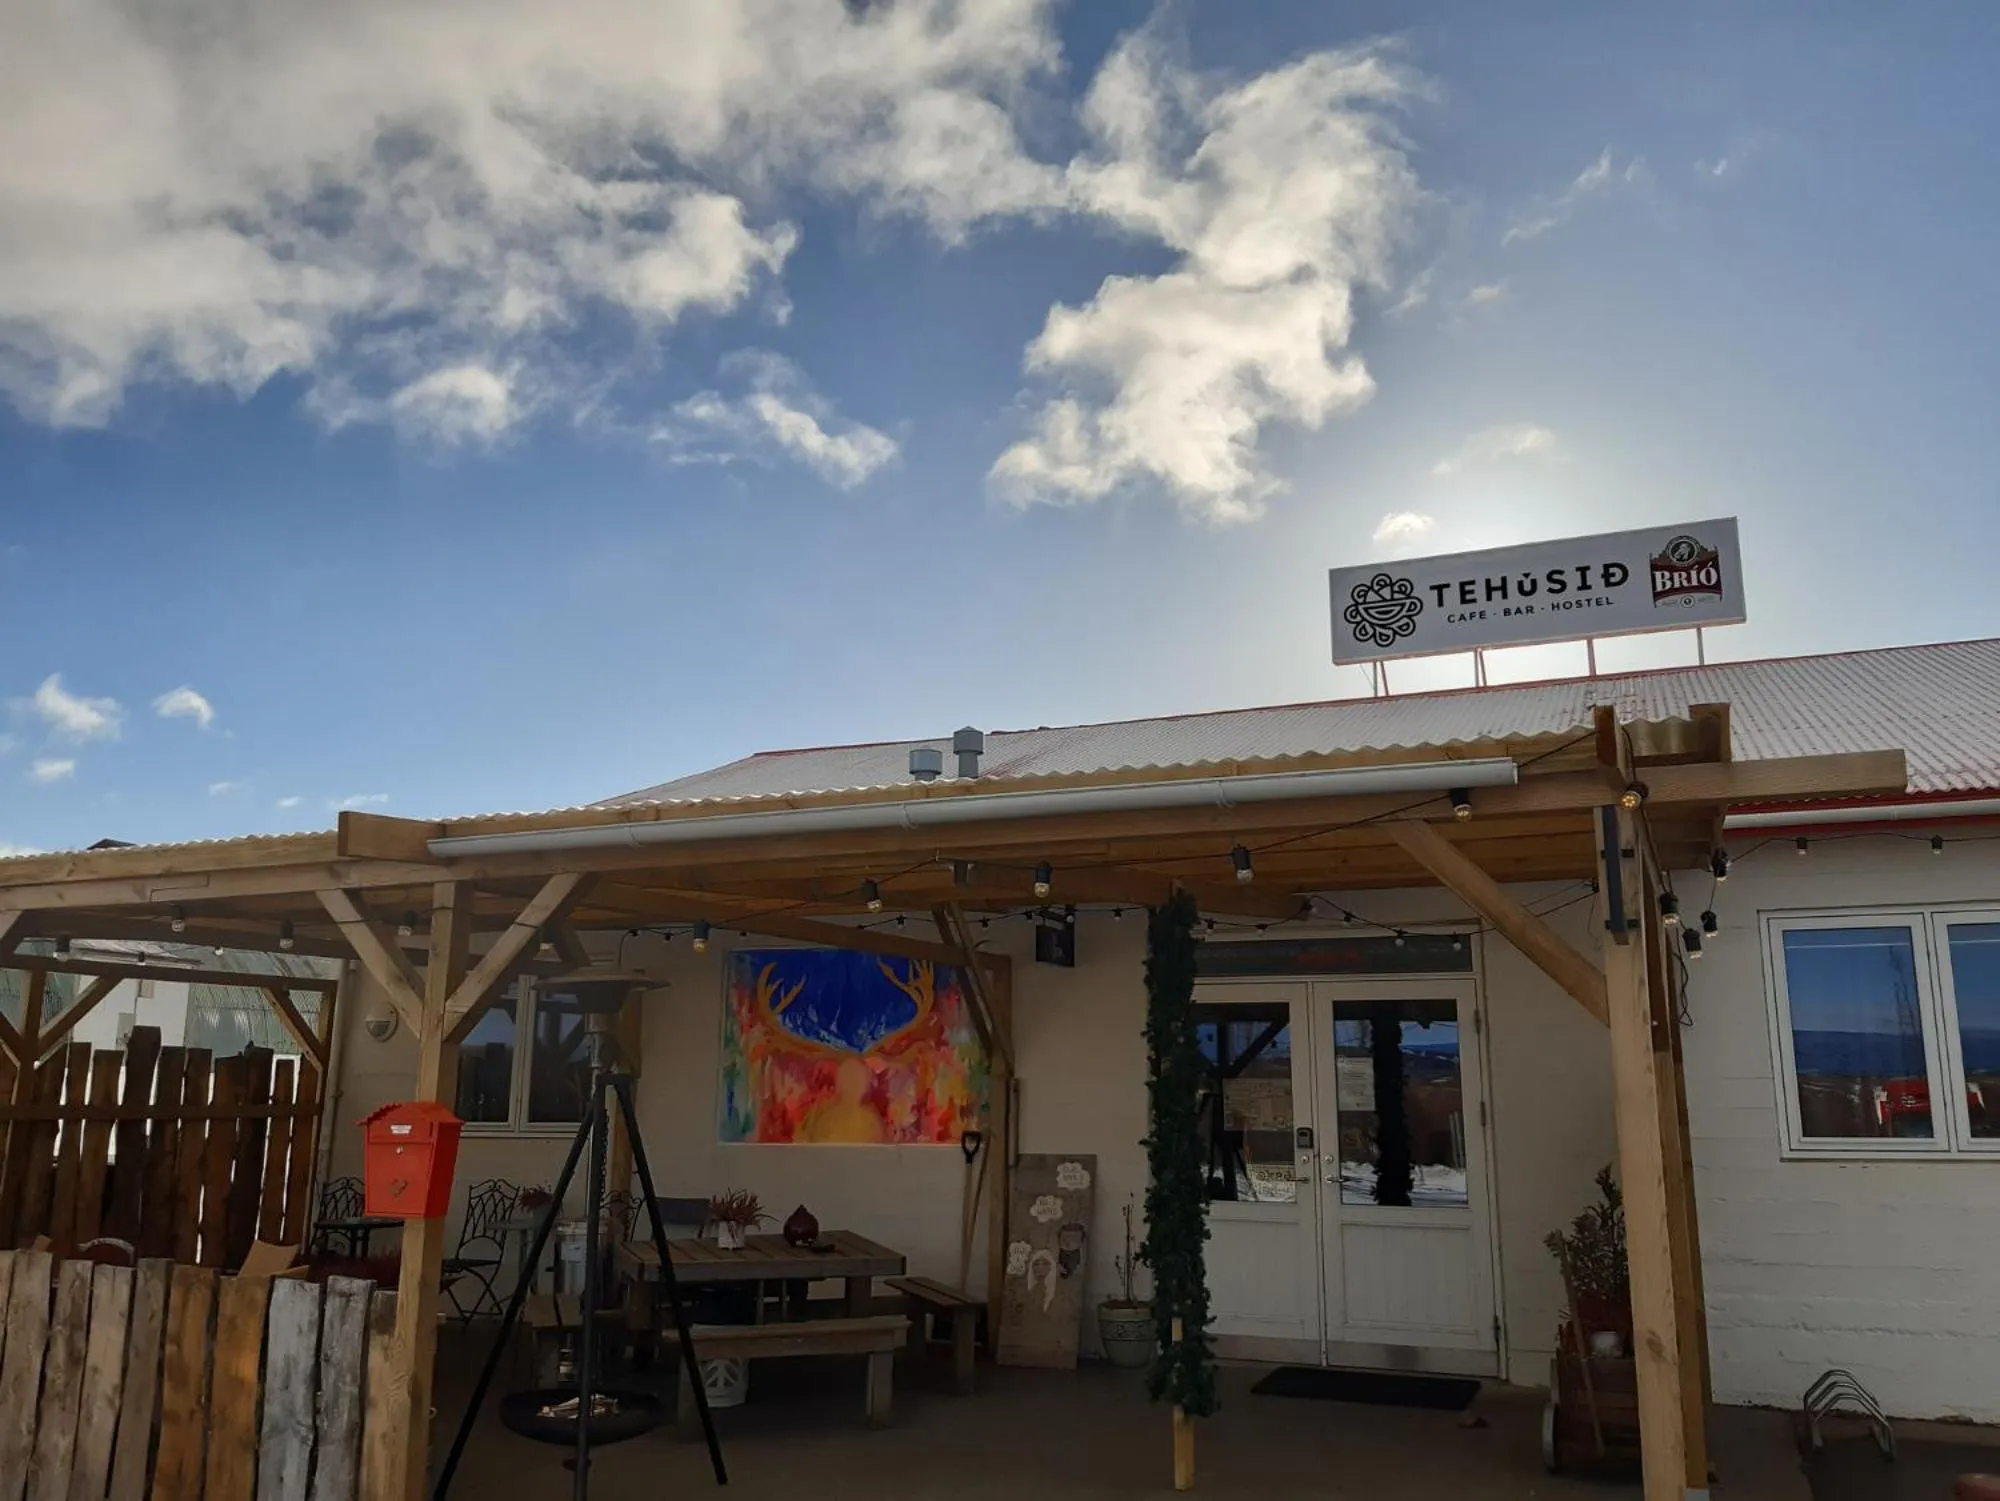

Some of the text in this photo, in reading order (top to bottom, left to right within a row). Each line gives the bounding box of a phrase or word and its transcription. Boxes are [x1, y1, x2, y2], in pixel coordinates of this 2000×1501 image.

[1652, 562, 1718, 593] BRÍÓ
[1447, 596, 1615, 623] CAFE BAR HOSTEL
